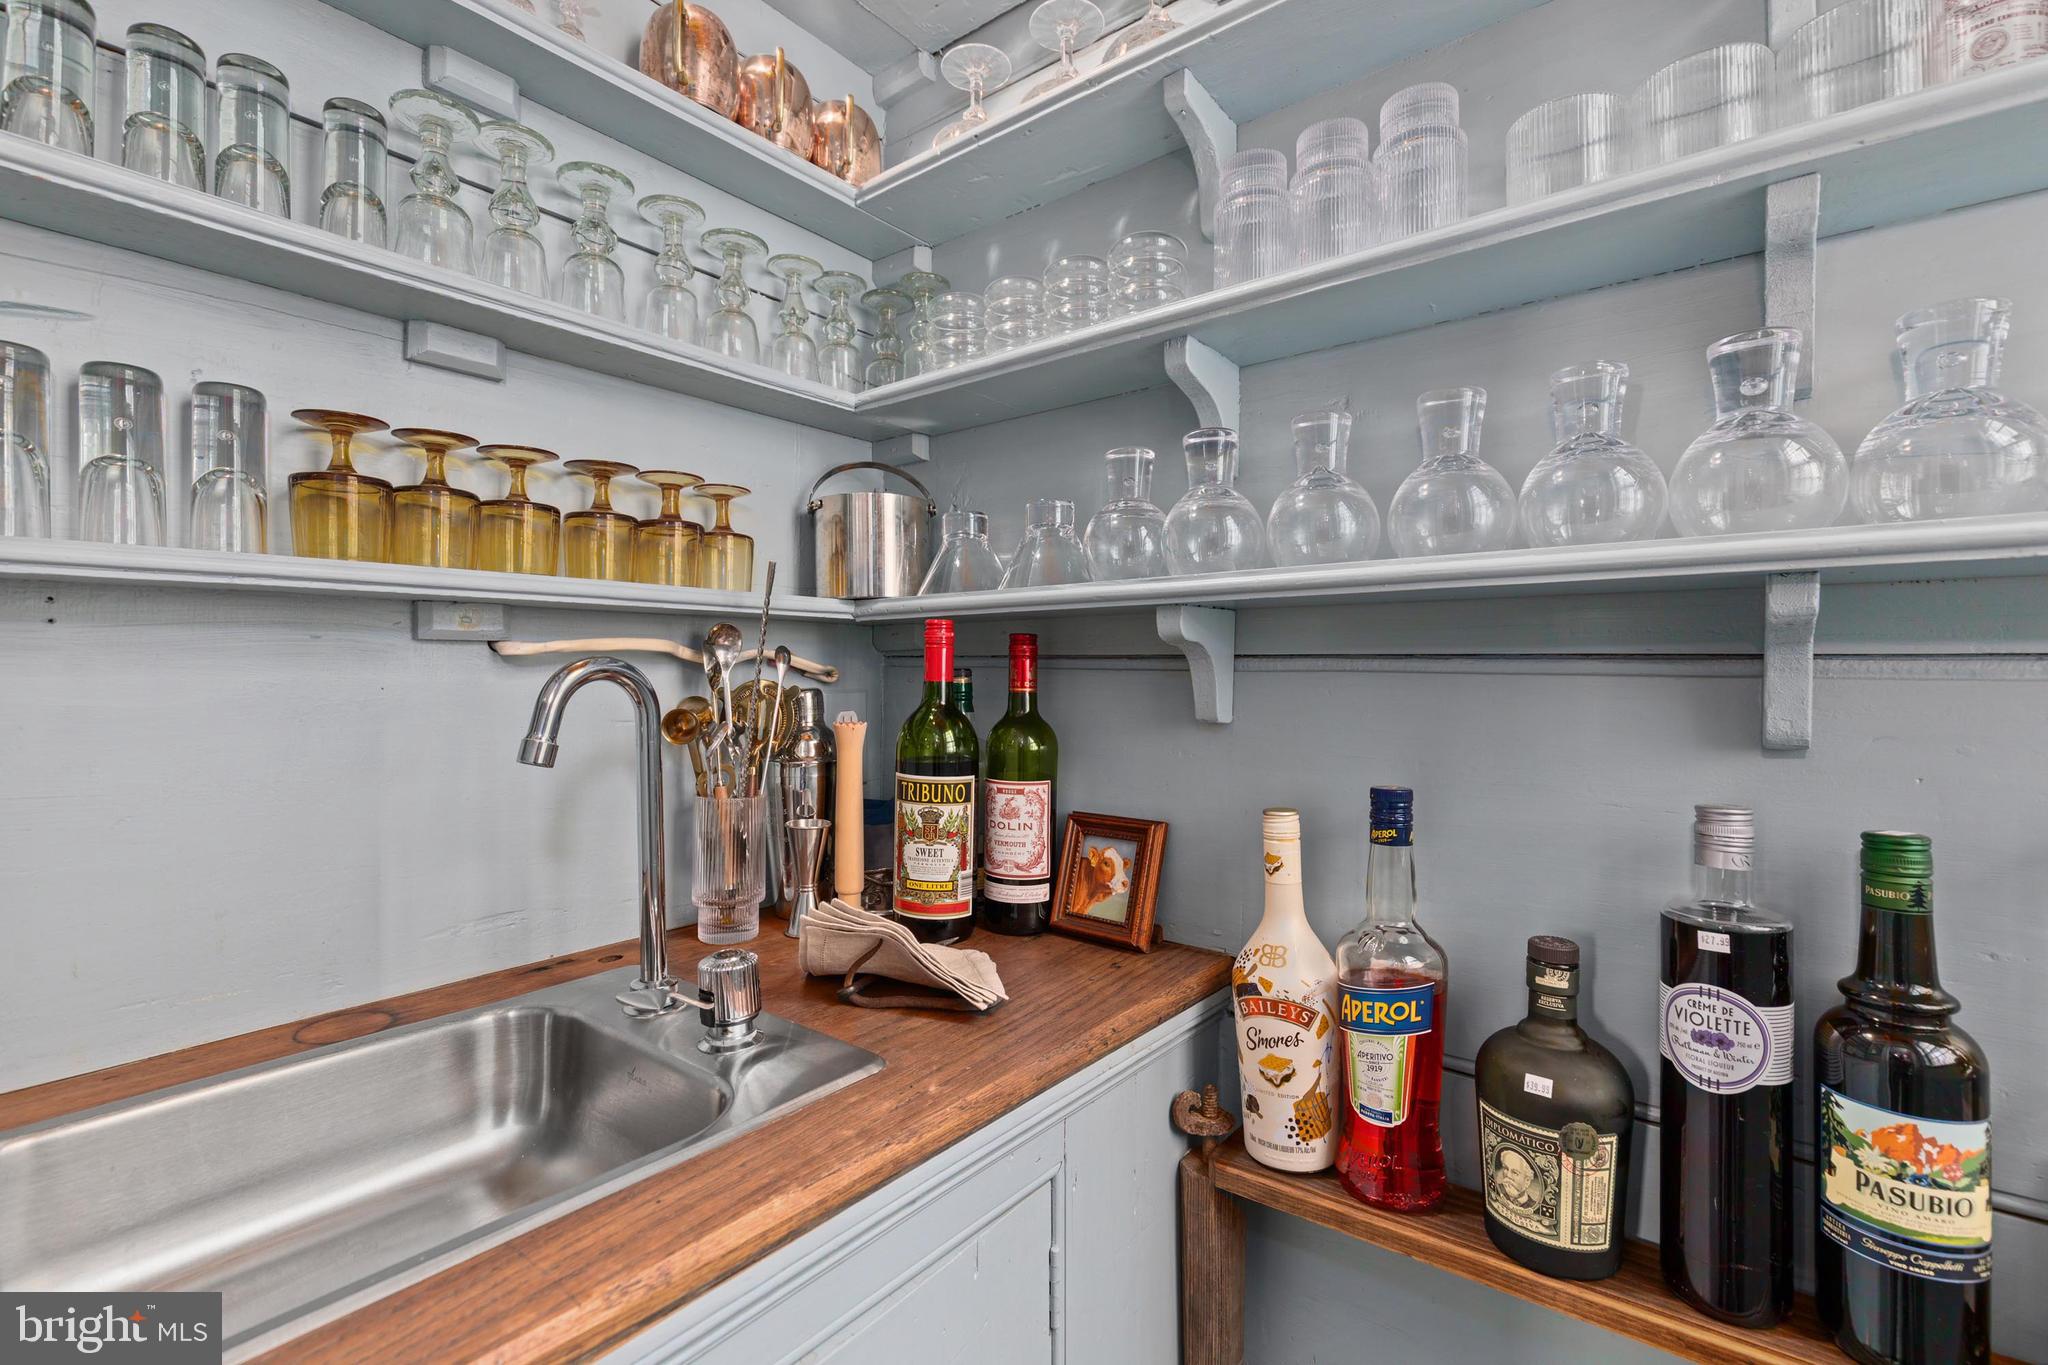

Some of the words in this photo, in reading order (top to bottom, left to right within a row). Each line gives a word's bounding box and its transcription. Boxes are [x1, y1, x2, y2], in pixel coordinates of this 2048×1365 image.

[901, 781, 966, 803] TRIBUNO
[989, 820, 1033, 831] DOLIN
[1371, 828, 1398, 839] APEROL
[994, 840, 1027, 848] VERMOUTH
[915, 846, 944, 858] SWEET
[908, 881, 924, 889] ONE
[926, 882, 950, 890] LITRE
[1865, 884, 1911, 901] PASUBIO
[1240, 1000, 1311, 1024] BAILEYS
[1341, 993, 1422, 1026] APEROL
[1721, 1006, 1734, 1017] DE
[1674, 1004, 1751, 1037] VIOLETTE
[1246, 1026, 1305, 1051] S'mores
[1357, 1050, 1394, 1062] APERITIVO
[1366, 1064, 1383, 1073] 1919
[1708, 1059, 1735, 1071] LIQUEUR
[1484, 1117, 1555, 1153] DIPLOMÁTICO
[1855, 1170, 1973, 1218] PASUBIO
[1876, 1203, 1909, 1217] VINO
